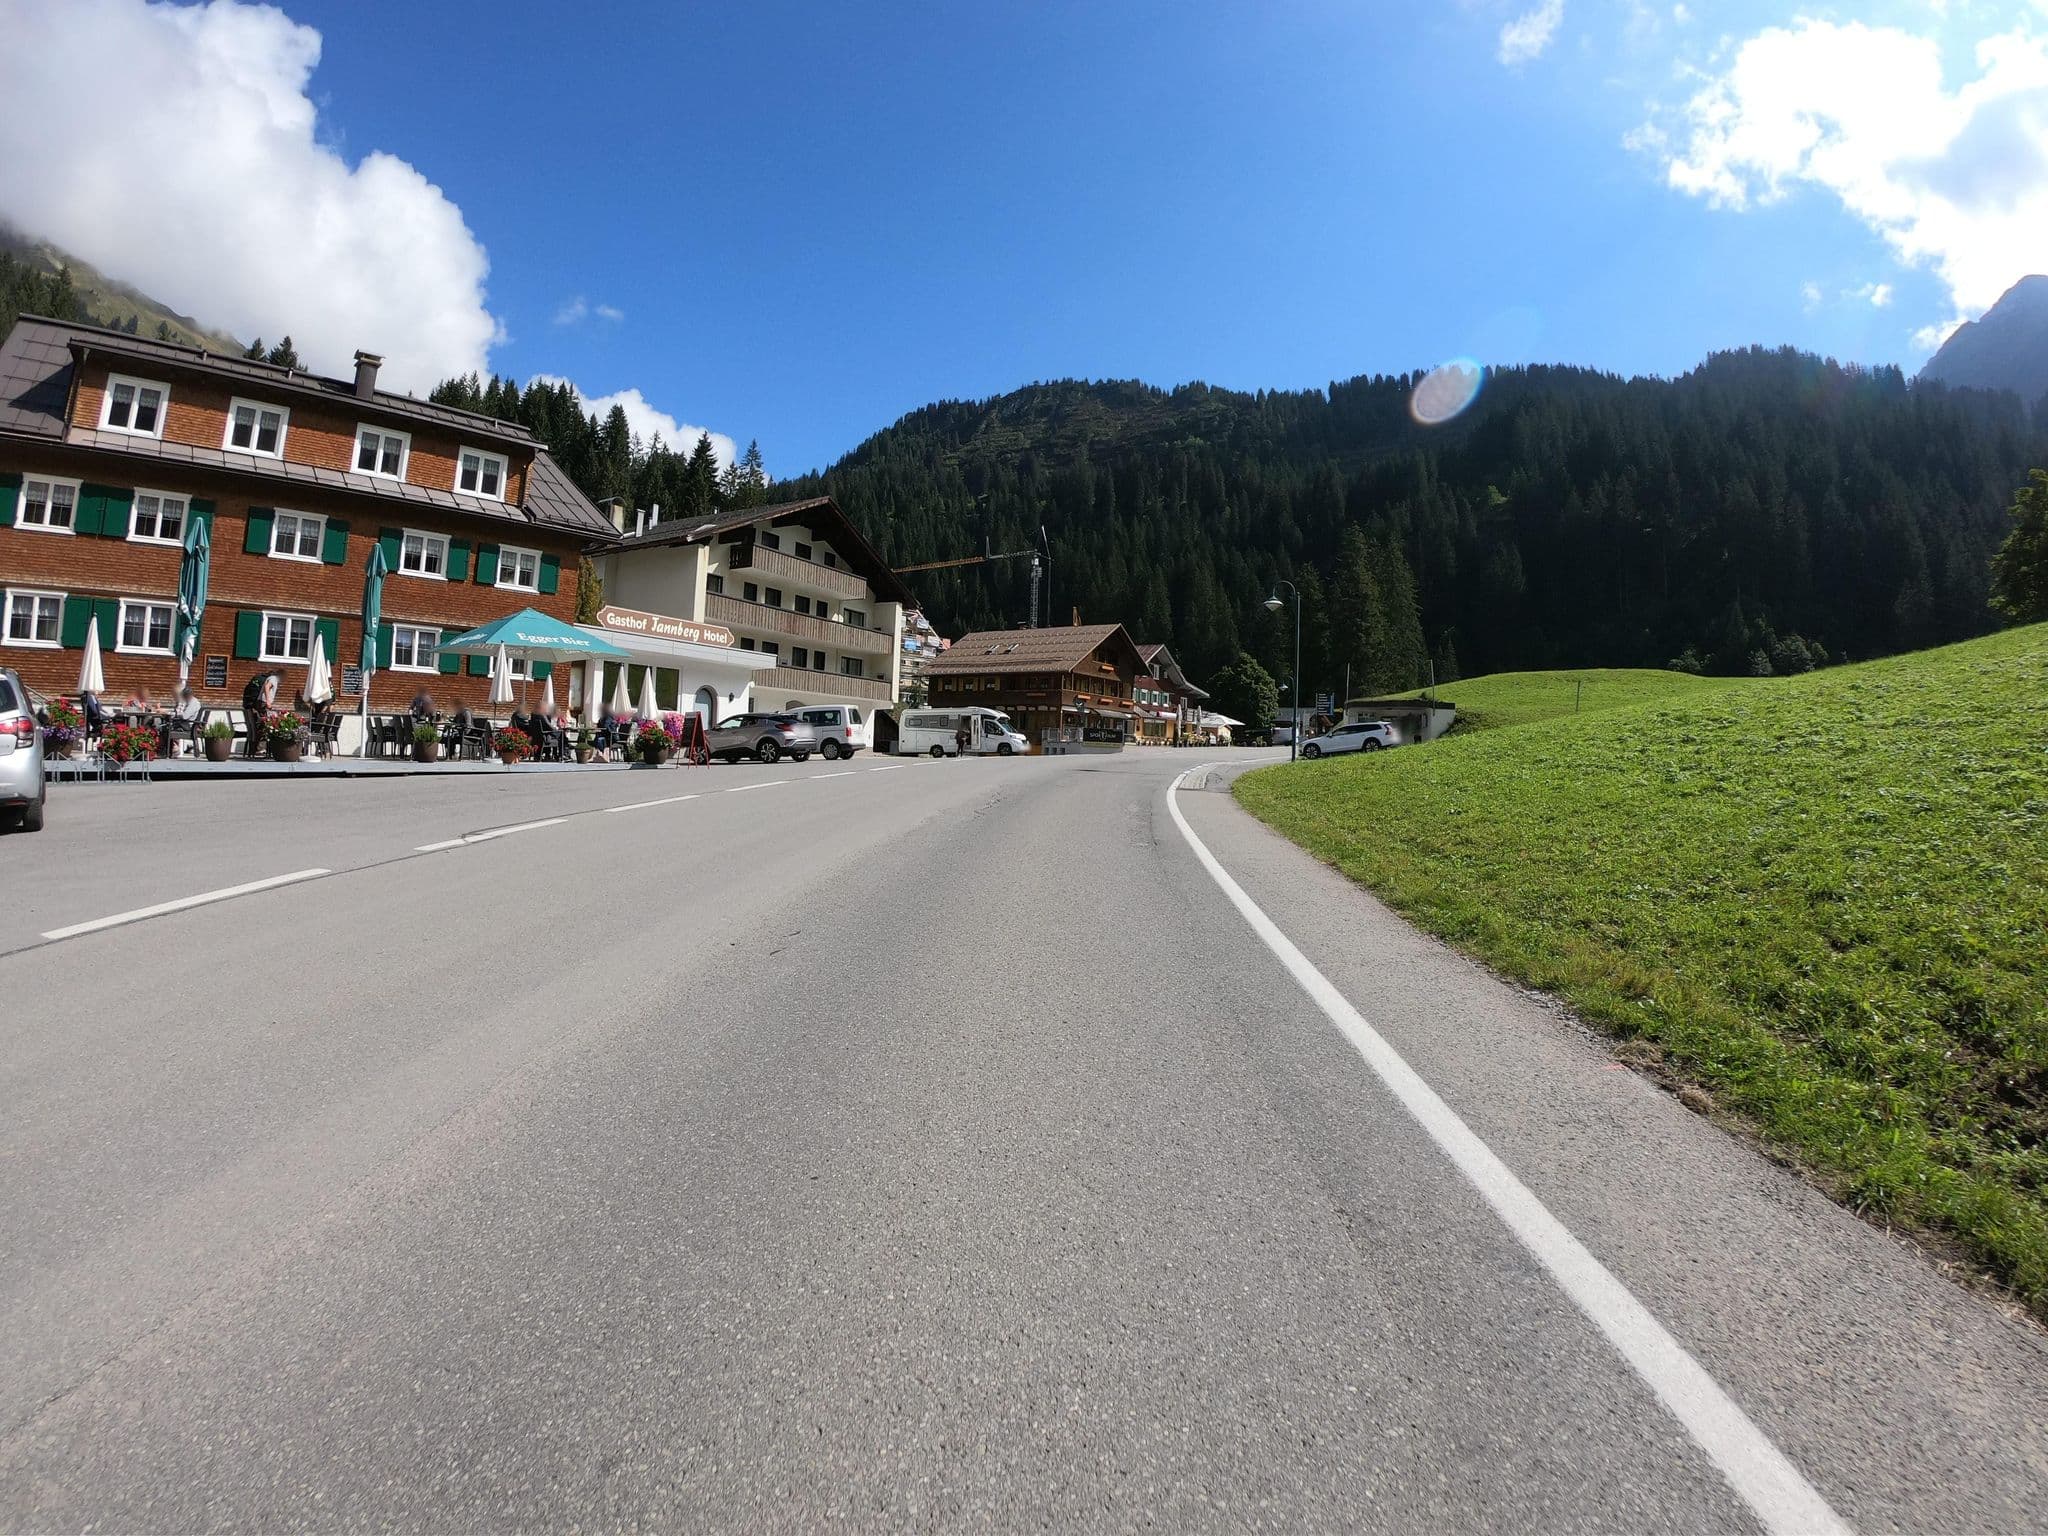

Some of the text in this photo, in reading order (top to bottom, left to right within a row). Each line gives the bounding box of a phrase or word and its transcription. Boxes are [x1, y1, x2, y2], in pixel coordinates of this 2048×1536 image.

[516, 632, 591, 647] Egger Bier
[606, 612, 728, 644] Gasthof Tannberg Hotel
